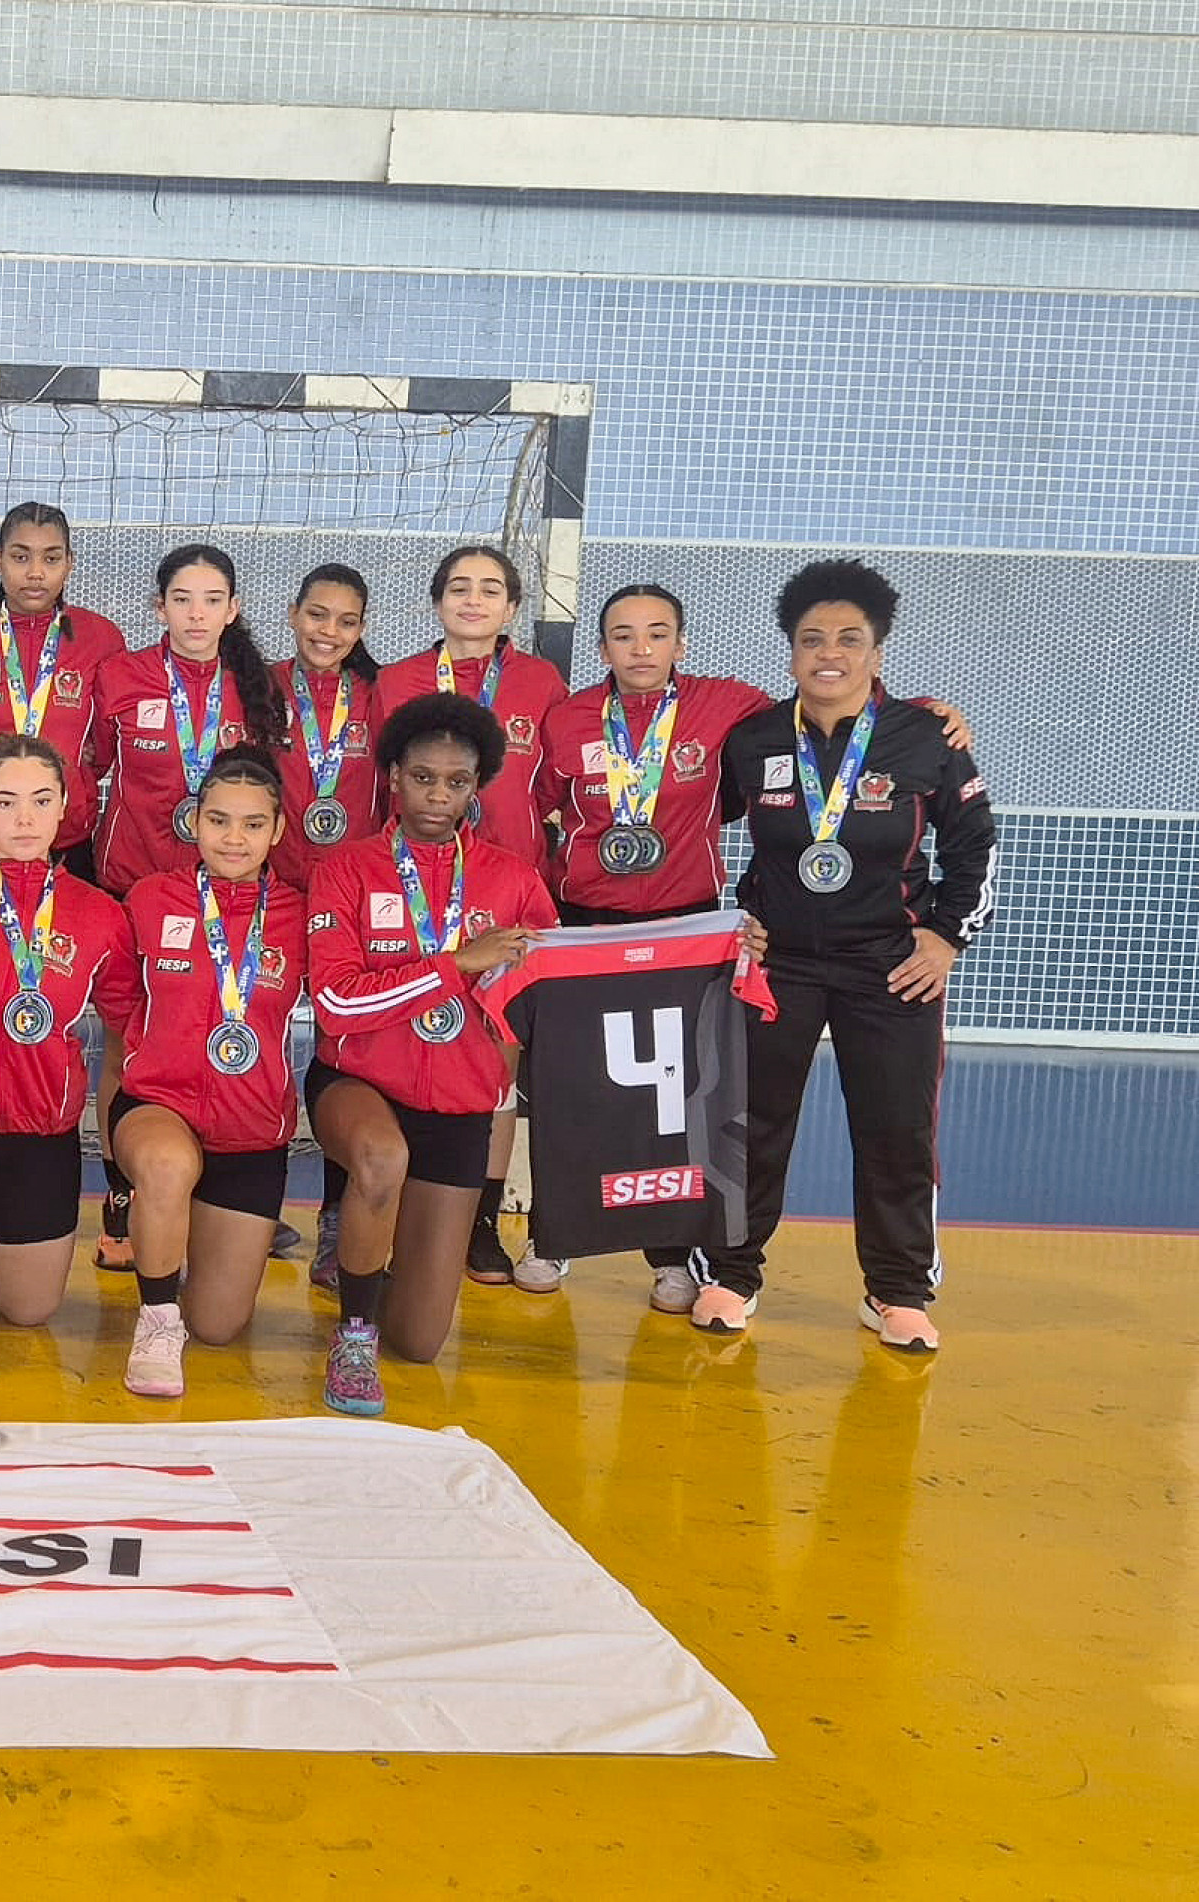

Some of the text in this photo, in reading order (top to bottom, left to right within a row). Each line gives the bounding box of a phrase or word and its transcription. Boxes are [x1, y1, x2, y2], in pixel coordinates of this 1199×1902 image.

[133, 738, 167, 750] FIESP
[585, 785, 609, 795] FIES
[961, 776, 986, 799] SE
[307, 911, 331, 935] SI
[369, 940, 407, 952] FIESP
[156, 958, 190, 972] FIESP
[603, 1007, 686, 1135] 4
[611, 1169, 693, 1205] SESI
